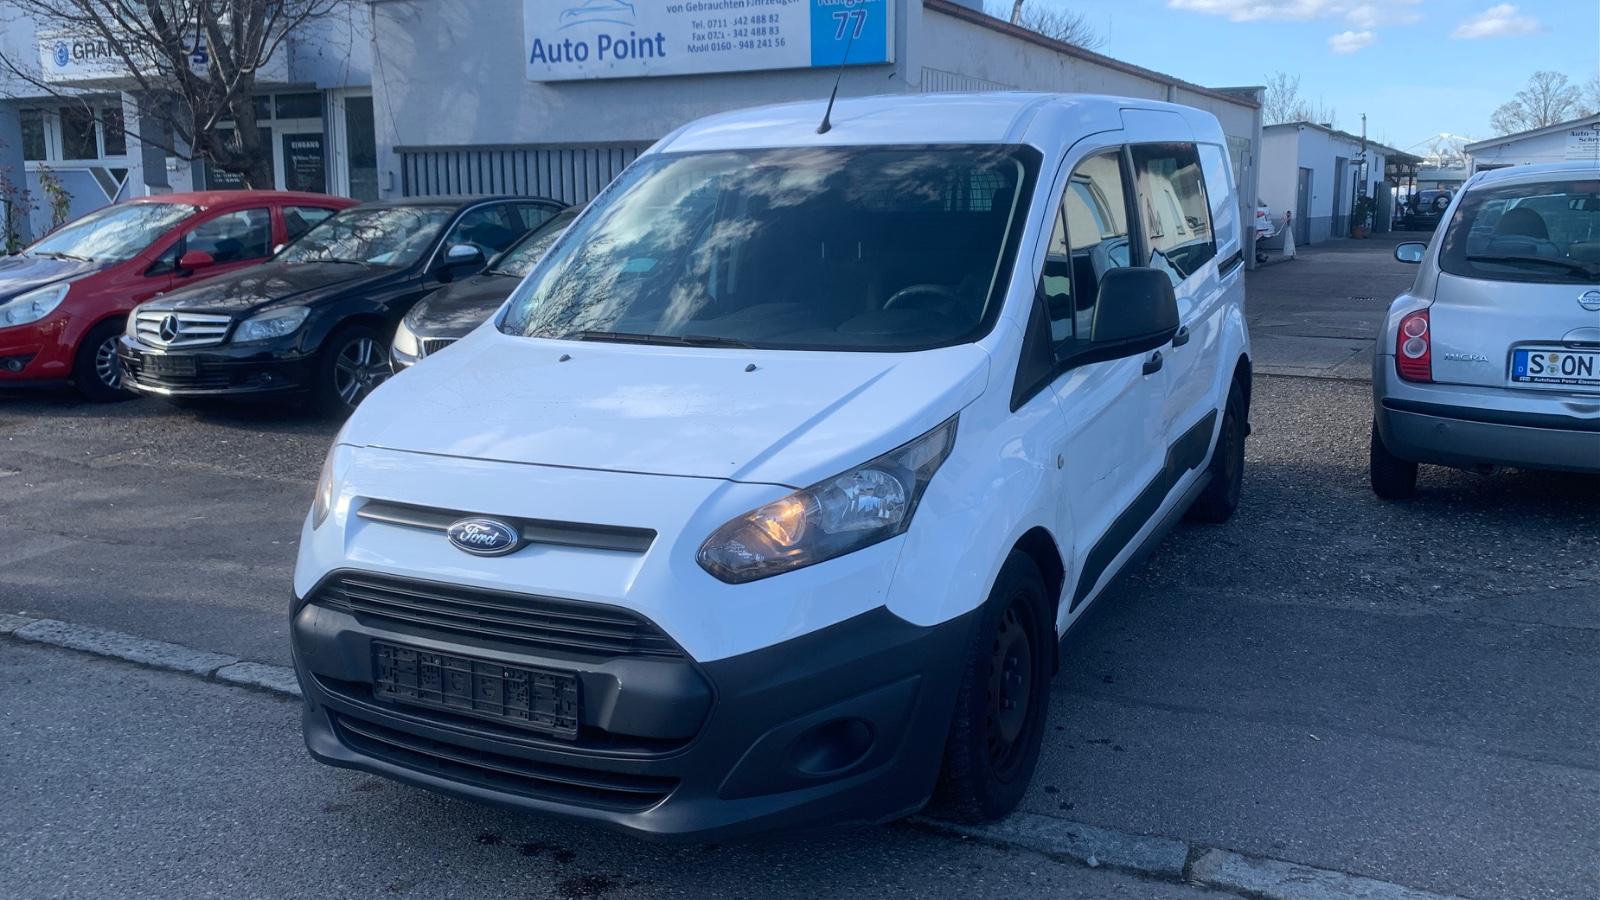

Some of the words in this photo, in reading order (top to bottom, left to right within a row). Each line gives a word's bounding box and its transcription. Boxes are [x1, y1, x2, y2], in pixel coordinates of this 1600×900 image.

[666, 5, 683, 14] von
[685, 0, 745, 12] Gebrauchten
[692, 20, 706, 30] Tel.
[707, 18, 728, 29] 0711
[750, 14, 767, 24] 488
[768, 13, 780, 23] 82
[832, 9, 868, 40] 77
[692, 32, 706, 41] Fax
[750, 27, 767, 36] 488
[768, 26, 780, 35] 83
[530, 38, 589, 64] Auto
[598, 31, 666, 60] Point
[687, 42, 710, 53] Mobil
[710, 41, 732, 52] 0160
[738, 39, 755, 50] 948
[756, 38, 773, 48] 241
[774, 37, 786, 47] 56
[1445, 352, 1489, 362] MICRA
[1529, 354, 1545, 374] S
[1562, 355, 1594, 376] ON
[460, 523, 499, 546] Ford
